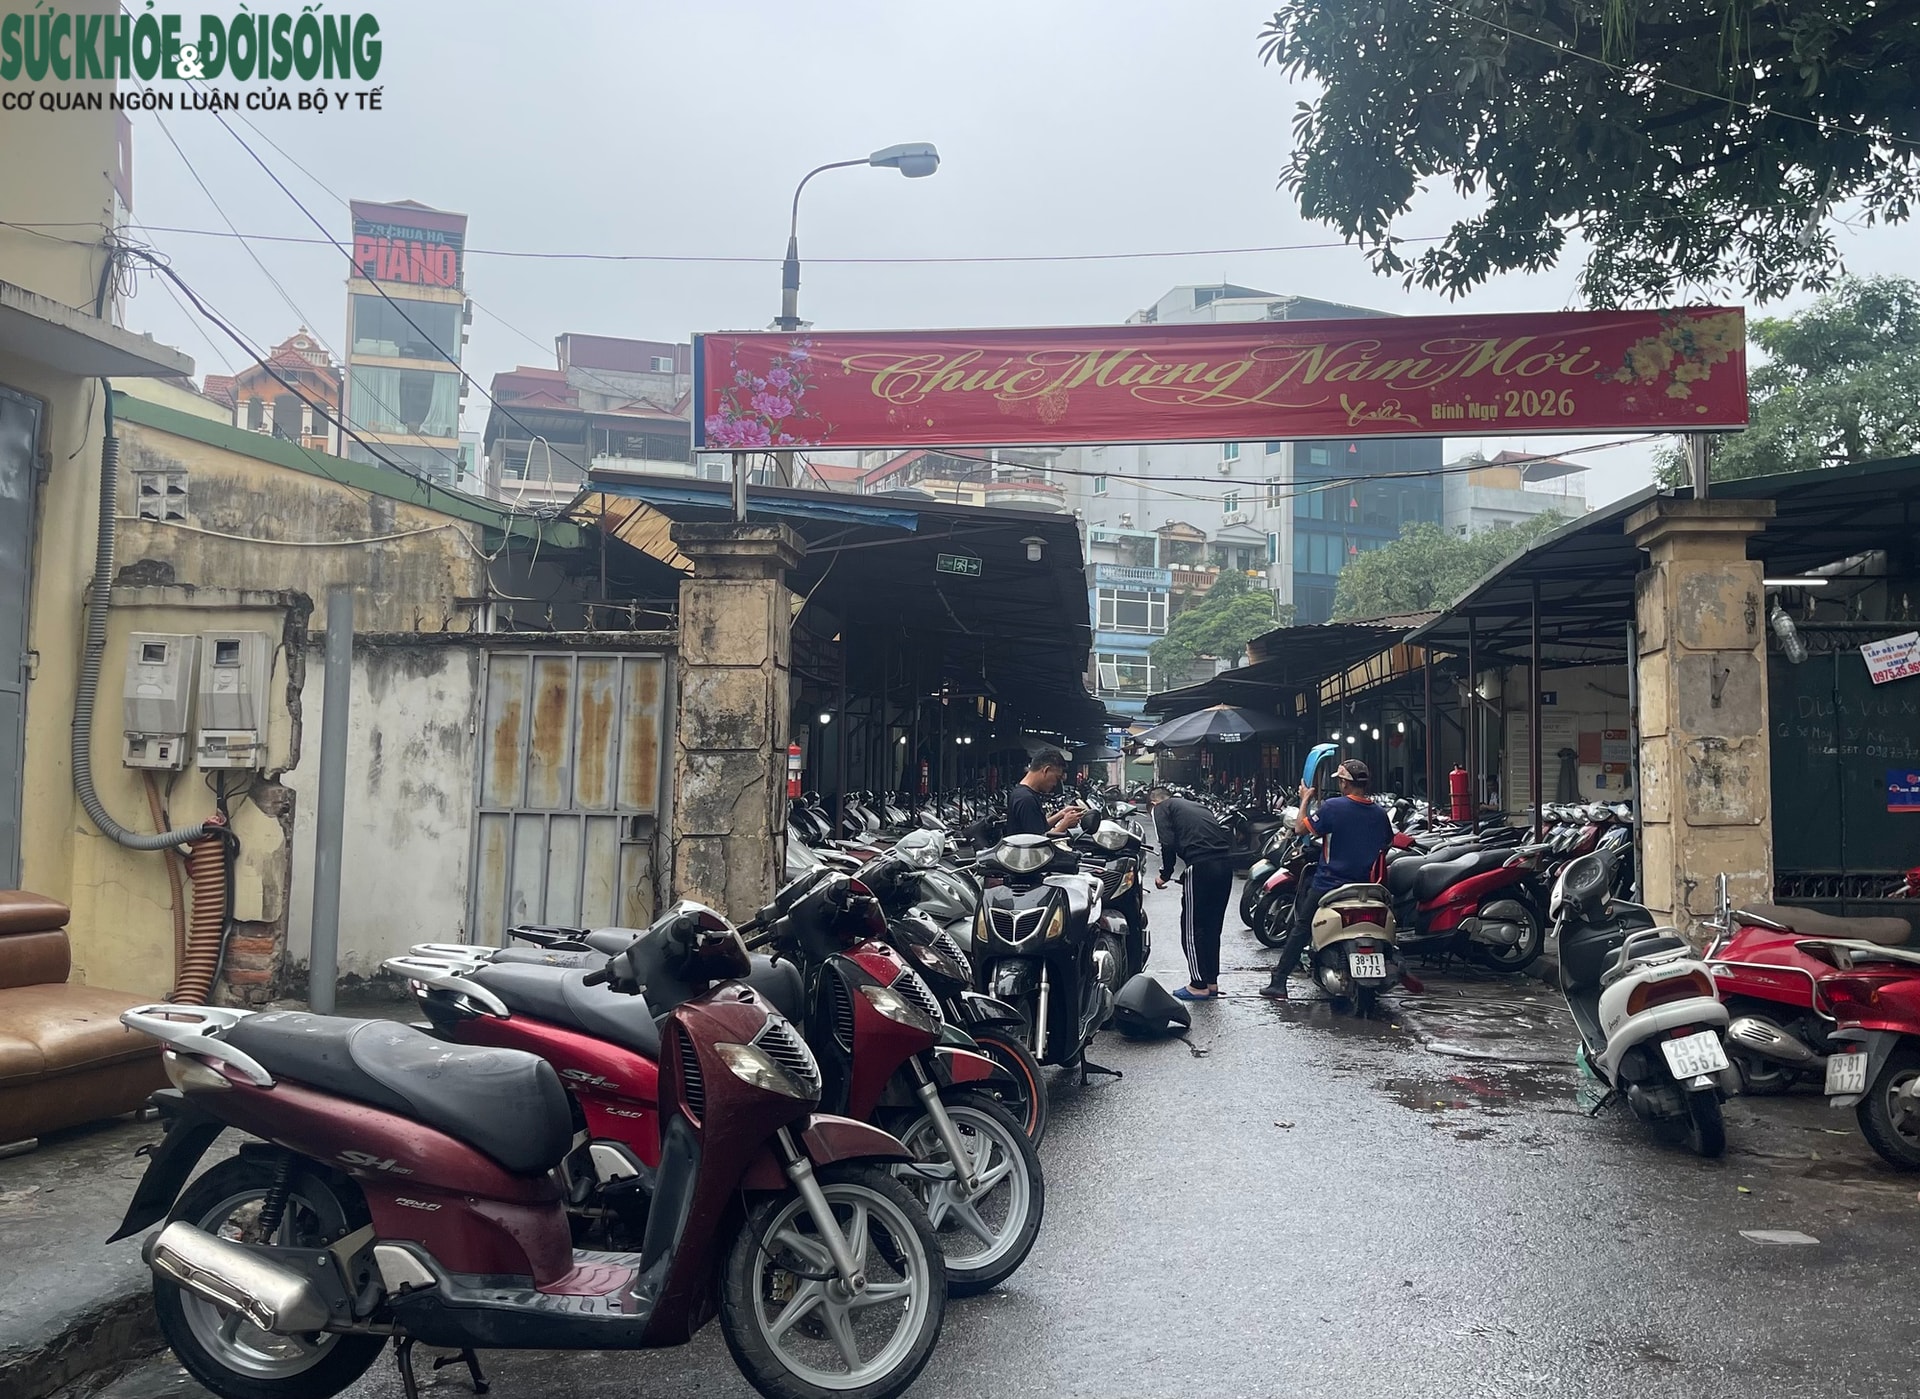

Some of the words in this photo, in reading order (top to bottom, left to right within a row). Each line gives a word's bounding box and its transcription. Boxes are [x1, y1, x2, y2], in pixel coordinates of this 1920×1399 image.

[354, 234, 456, 288] PIANO
[842, 348, 1052, 405] Chúc
[1000, 346, 1256, 411] Mừng
[1250, 338, 1440, 394] Năm
[1395, 336, 1601, 391] Mới
[1503, 388, 1576, 418] 2026
[1356, 966, 1381, 976] 0775
[1677, 1052, 1721, 1075] 0562
[335, 1150, 398, 1170] SH
